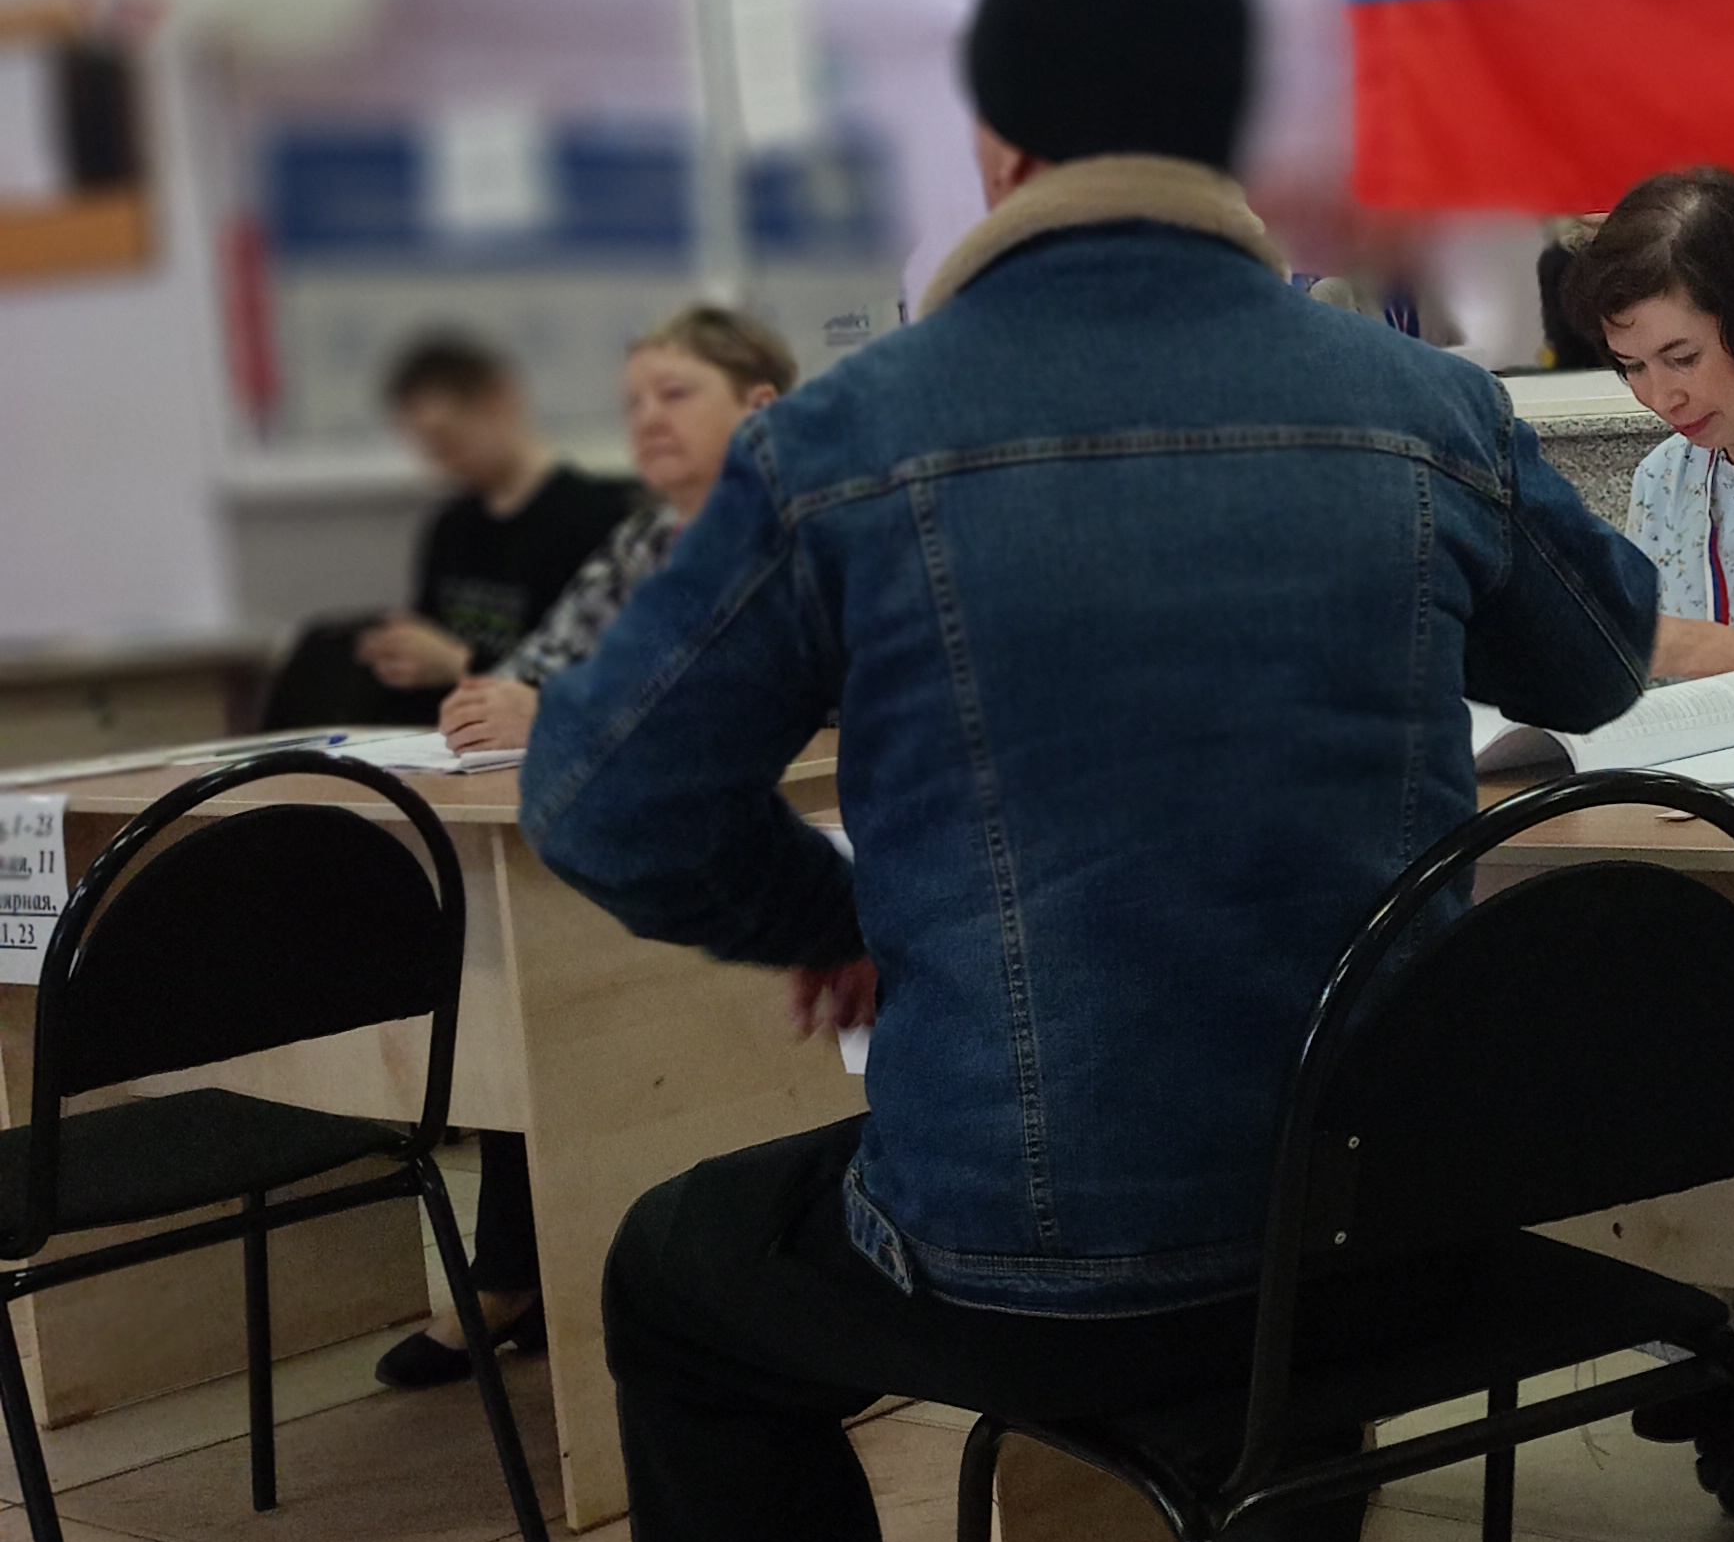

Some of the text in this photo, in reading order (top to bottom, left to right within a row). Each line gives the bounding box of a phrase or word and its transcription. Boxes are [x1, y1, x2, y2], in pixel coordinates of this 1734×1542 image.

[39, 850, 55, 873] 11
[0, 893, 57, 914] ярная,
[18, 924, 35, 944] 23
